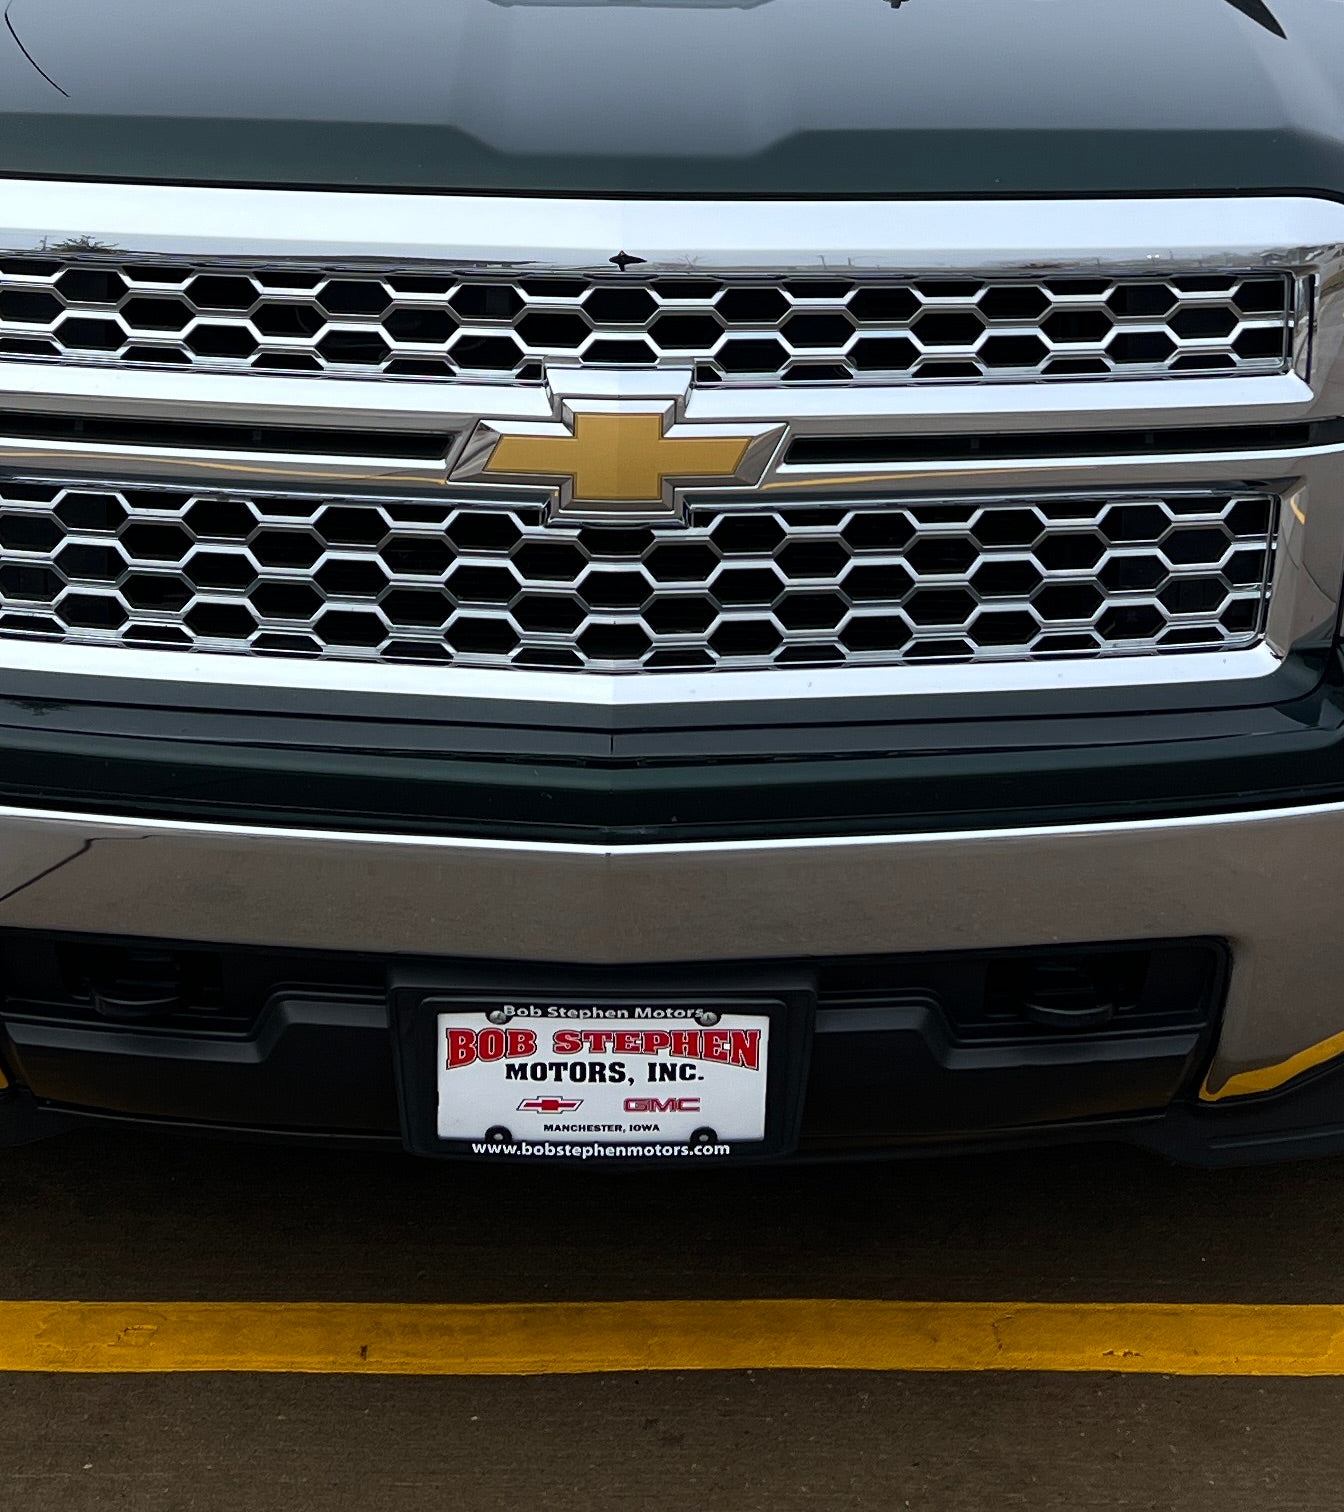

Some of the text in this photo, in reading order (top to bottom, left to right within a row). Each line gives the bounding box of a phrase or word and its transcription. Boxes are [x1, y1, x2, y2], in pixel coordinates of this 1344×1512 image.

[504, 1005, 704, 1020] Bob Stephen Motors
[446, 1027, 761, 1071] BOB STEPHEN
[506, 1062, 704, 1086] MOTORS, INC.
[623, 1098, 700, 1112] GMC
[543, 1124, 660, 1133] MANCHESTER, IOWA
[472, 1142, 730, 1159] www.bobstephenmotors.com
